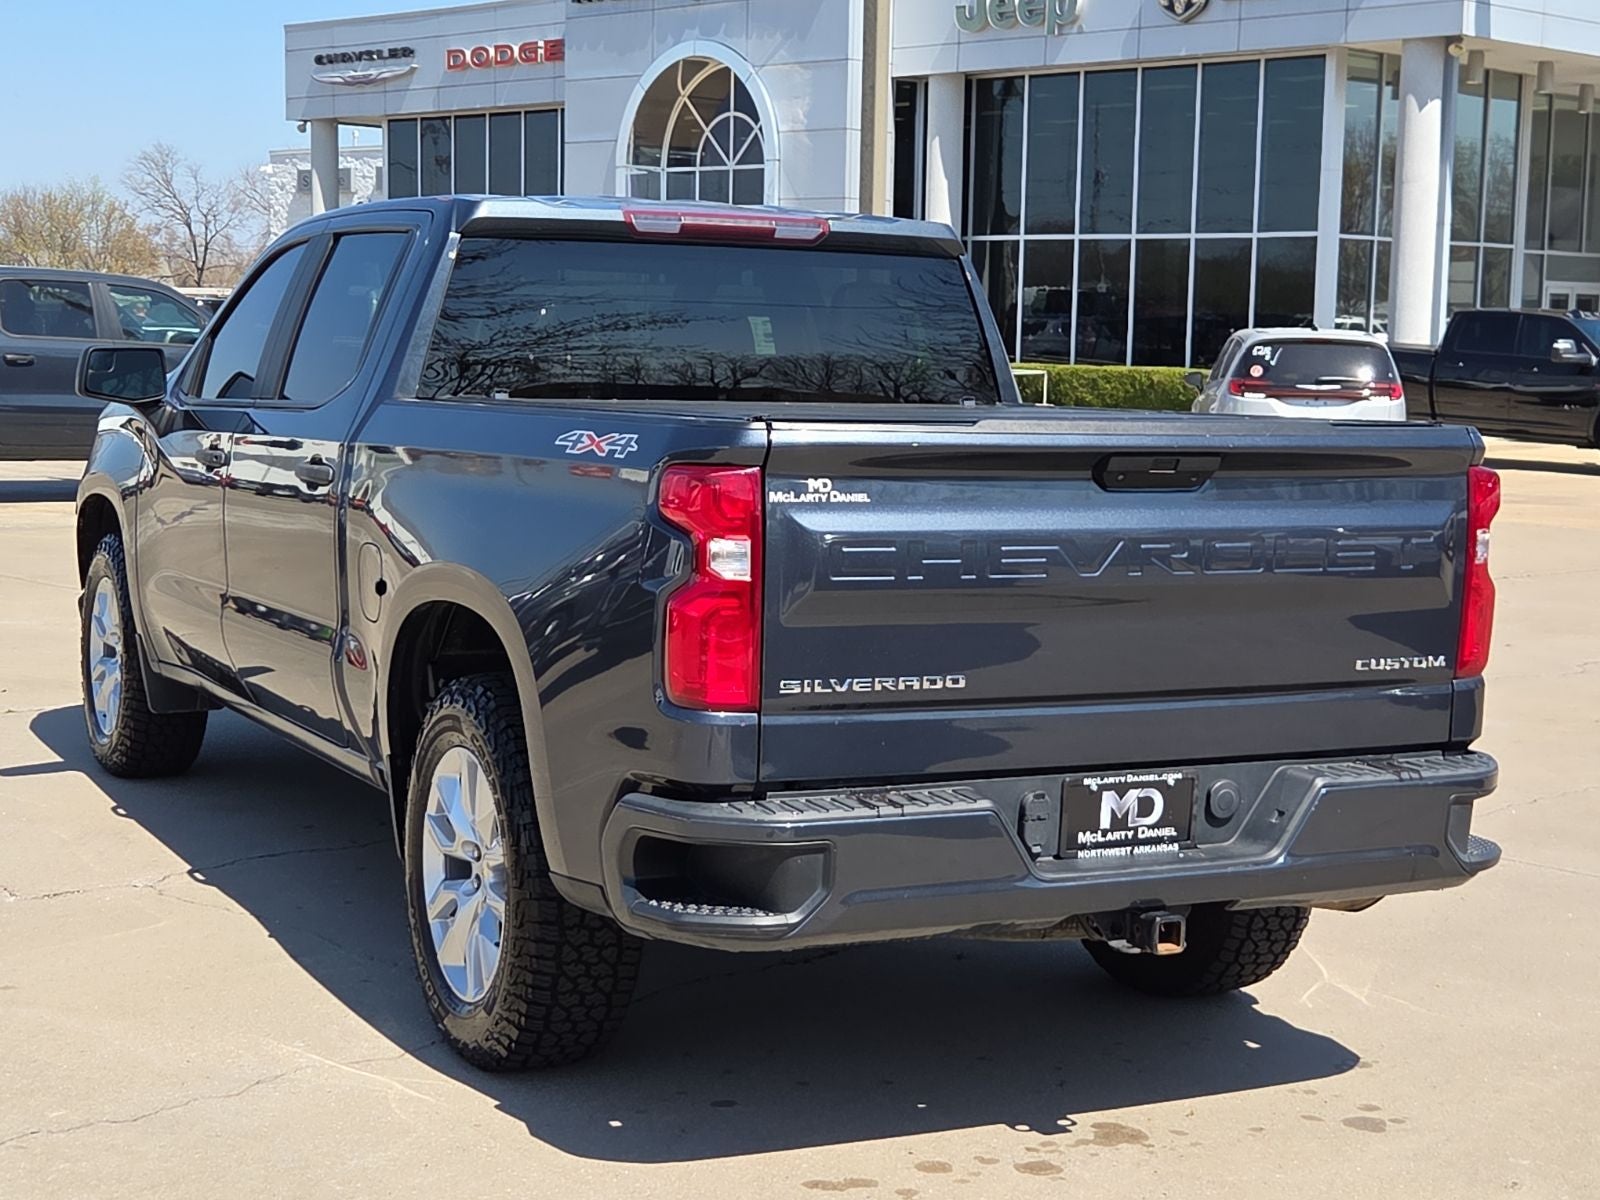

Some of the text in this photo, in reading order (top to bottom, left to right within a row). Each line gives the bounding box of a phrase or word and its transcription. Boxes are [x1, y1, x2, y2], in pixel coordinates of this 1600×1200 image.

[314, 46, 415, 66] CHRYSLER
[446, 38, 565, 72] DODGE
[807, 478, 832, 492] MD
[829, 536, 1434, 582] CHEVROLET
[1355, 655, 1446, 671] CUSTOM
[779, 674, 967, 694] SILVERADO
[1100, 787, 1164, 830] MD
[1077, 842, 1179, 859] NORTHWEST ARKANSAS
